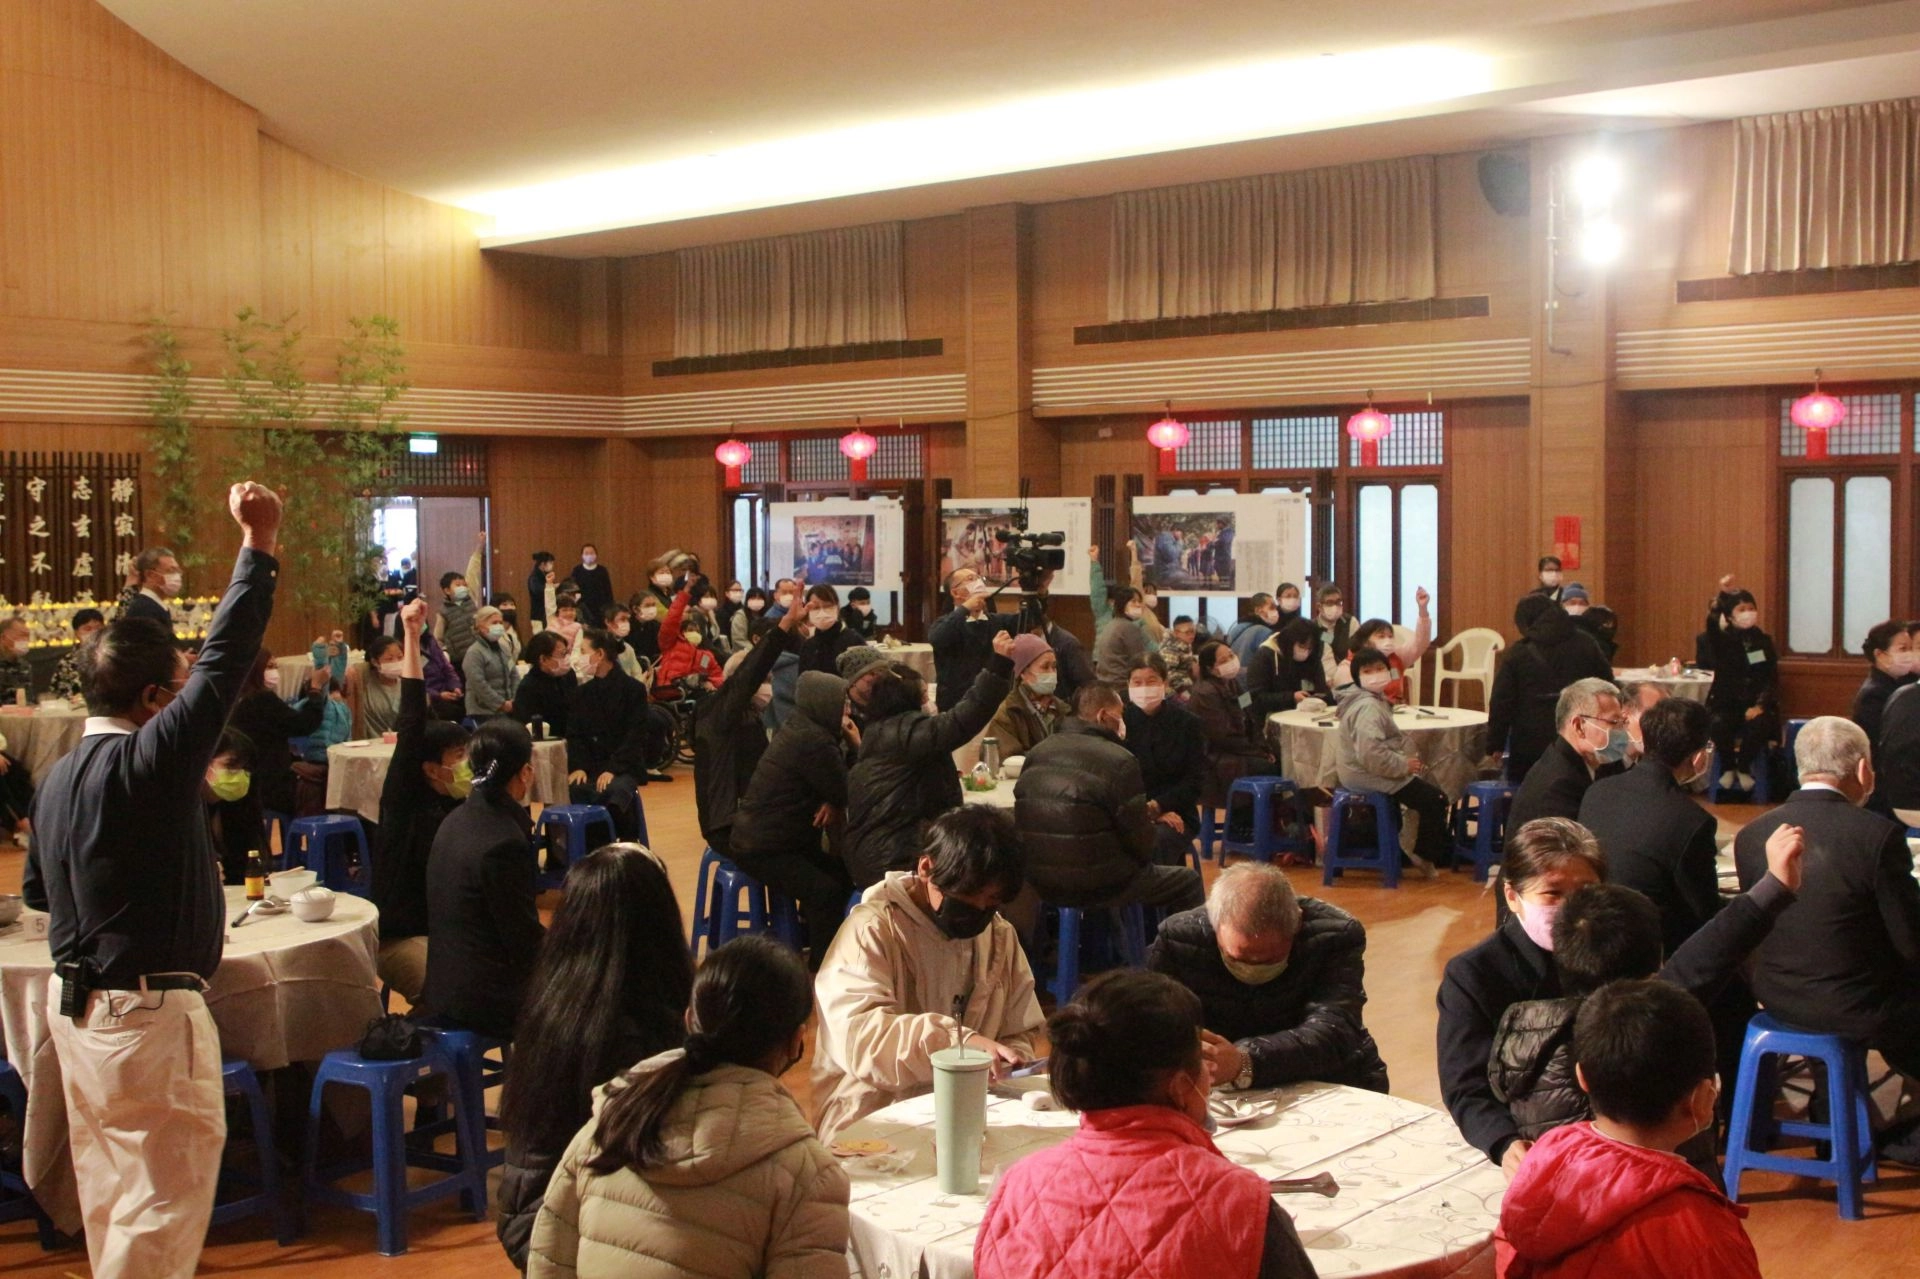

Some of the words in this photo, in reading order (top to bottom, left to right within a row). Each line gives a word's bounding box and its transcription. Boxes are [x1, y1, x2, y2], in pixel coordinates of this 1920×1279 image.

[111, 477, 136, 601] 靜寂清
[35, 917, 46, 933] 5
